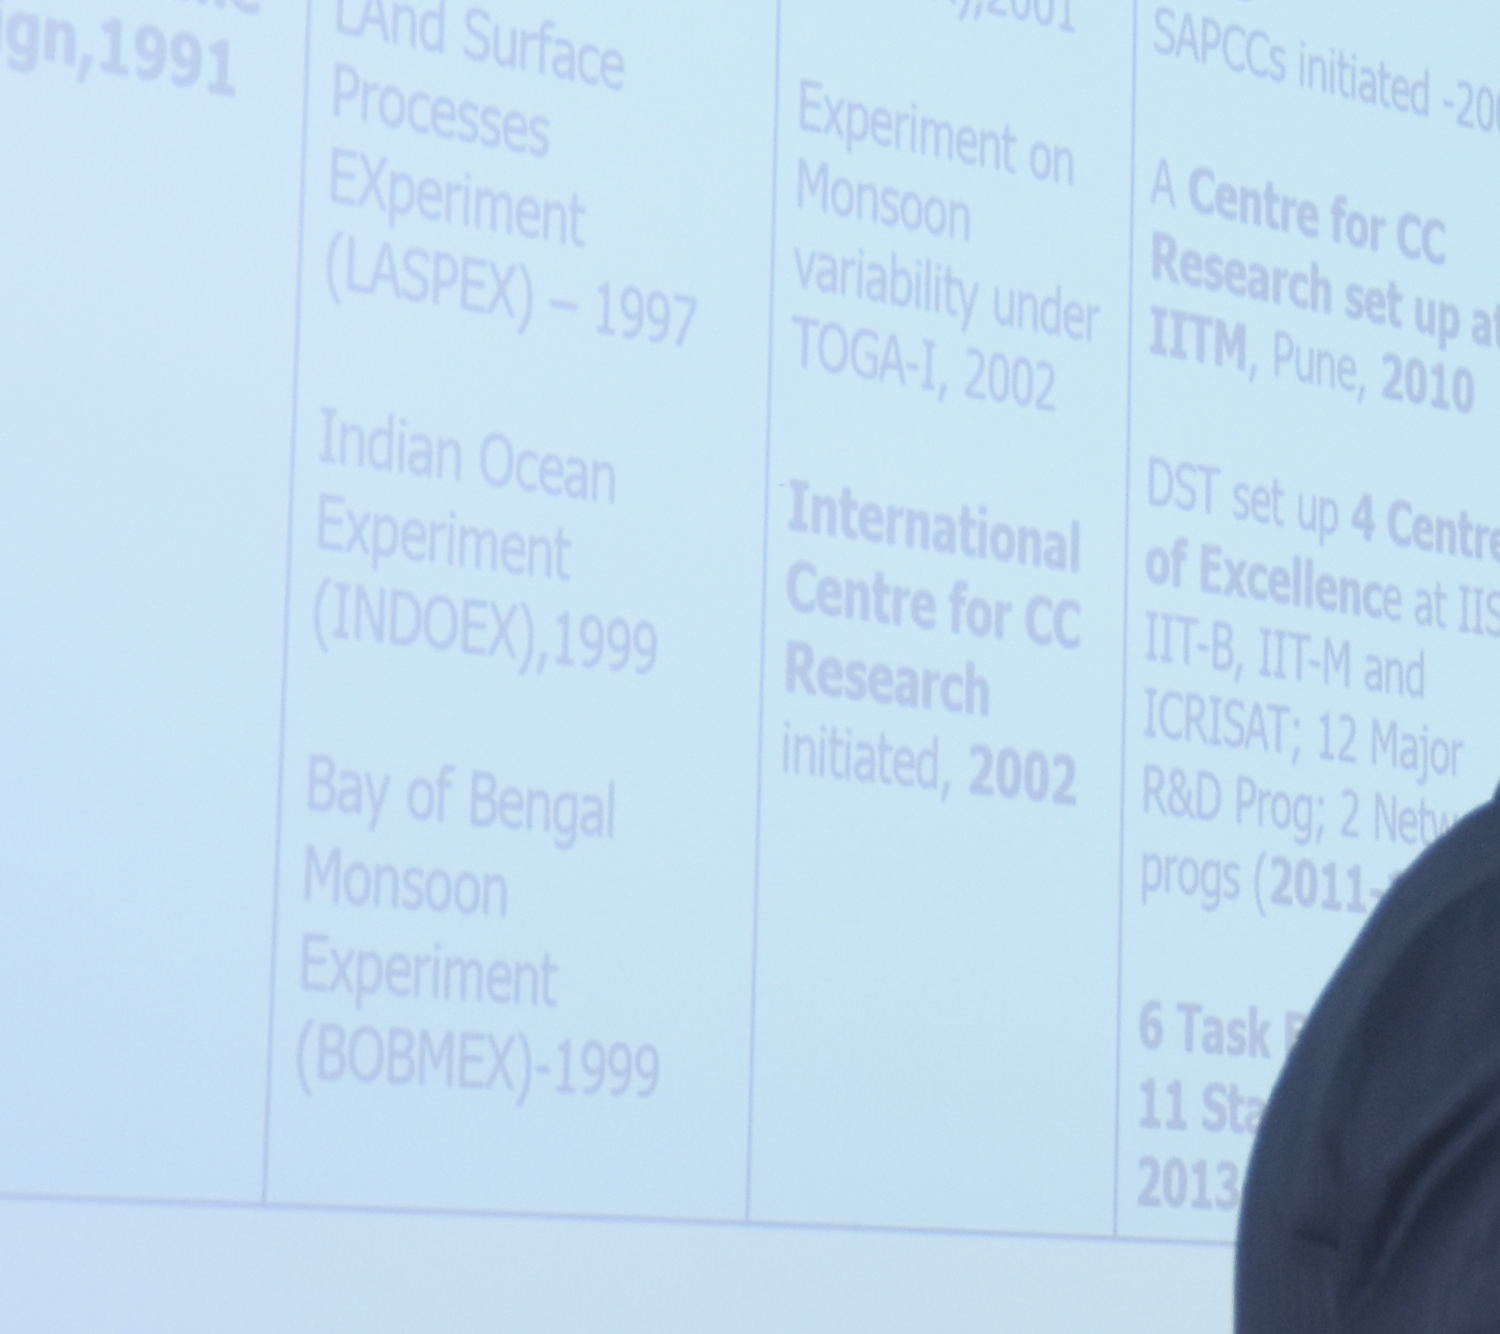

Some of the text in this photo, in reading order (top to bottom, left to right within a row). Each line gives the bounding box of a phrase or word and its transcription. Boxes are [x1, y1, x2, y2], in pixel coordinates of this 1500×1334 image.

[462, 6, 626, 92] Surface
[1153, 5, 1430, 118] SAPCCs initiated
[332, 62, 551, 159] Processes
[798, 77, 1075, 186] Experiment on
[796, 157, 972, 241] Monsoon
[1188, 166, 1446, 266] Centre for CC
[325, 230, 698, 347] (LASPEX) 1997
[992, 285, 1101, 342] under
[1151, 231, 1333, 315] Research
[1345, 281, 1403, 329] set
[1414, 297, 1461, 351] up
[963, 346, 1056, 413] 2002
[1149, 305, 1475, 414] IITM, 2010
[318, 406, 617, 504] Indian Ocean
[316, 492, 573, 583] Experiment
[788, 478, 1081, 573] International
[1147, 455, 1222, 514] DST
[1232, 478, 1285, 528] set
[1297, 494, 1340, 547] up
[785, 560, 1081, 650] Centre for CC
[1145, 536, 1447, 630] of Excellence at
[785, 639, 990, 717] Research
[1363, 650, 1426, 699] and
[968, 743, 1077, 806] 2002
[1142, 763, 1223, 822] R&D
[1319, 712, 1465, 787] 12 Major
[306, 753, 616, 852] Bay of Bengal
[303, 844, 508, 918] Monsoon
[1140, 852, 1242, 913] progs
[299, 932, 559, 1011] Experiment
[1176, 1001, 1271, 1059] Task
